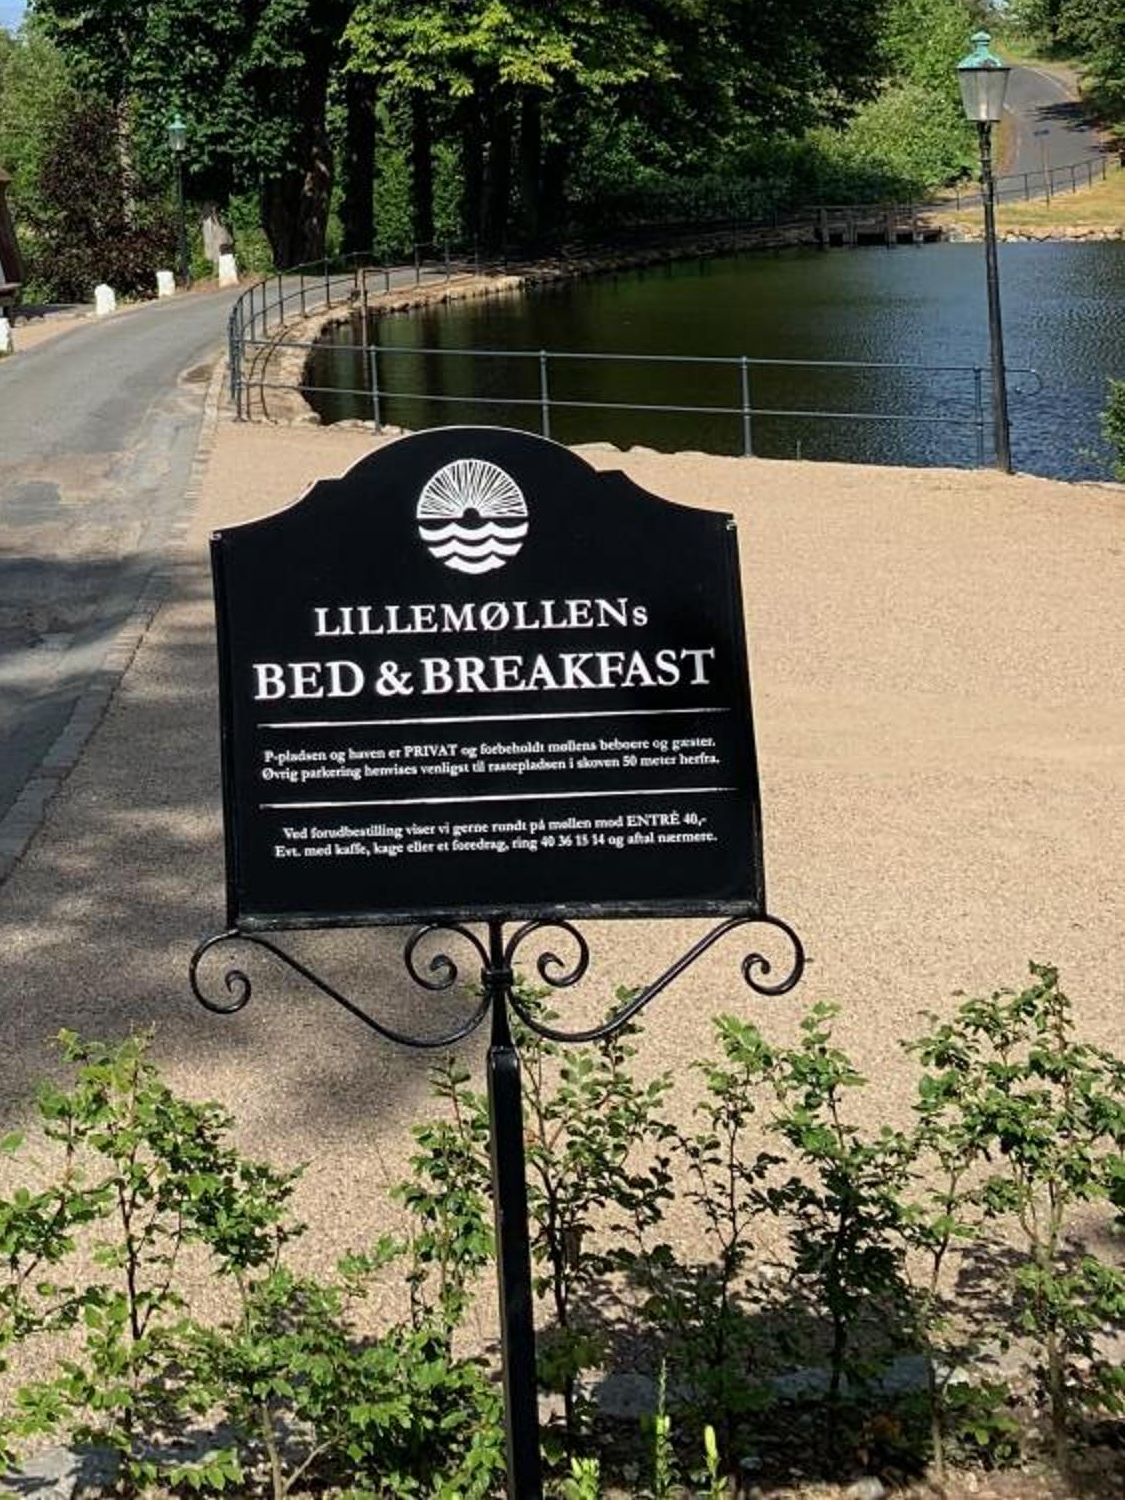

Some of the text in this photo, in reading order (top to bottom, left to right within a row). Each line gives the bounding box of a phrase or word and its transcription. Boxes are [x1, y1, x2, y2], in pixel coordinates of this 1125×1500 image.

[314, 597, 649, 637] LILLEMØLLENs
[252, 646, 716, 702] BED & BREAKFAST
[262, 766, 299, 783] Øvrig
[301, 765, 362, 783] parkering
[420, 761, 470, 777] venligst
[472, 759, 486, 773] til
[488, 757, 567, 775] rastepladsen
[569, 757, 575, 769] i
[576, 755, 620, 769] skoven
[622, 754, 638, 767] 50
[640, 755, 677, 767] meter
[678, 751, 721, 765] herfra.
[264, 749, 327, 767] P-pladsen
[329, 751, 346, 764] og
[348, 747, 386, 760] haven
[388, 748, 402, 759] er
[403, 743, 458, 758] PRIVAT
[460, 746, 478, 759] og
[599, 737, 650, 751] beboere
[652, 739, 669, 753] og
[282, 827, 308, 840] Ved
[310, 823, 404, 840] forudbestilling
[404, 822, 436, 836] viser
[437, 821, 450, 834] vi
[452, 822, 490, 837] gerne
[491, 819, 527, 833] rundt
[529, 817, 546, 835] på
[594, 814, 624, 829] mod
[626, 809, 681, 827] ENTRÉ
[275, 844, 302, 858] Evt.
[304, 843, 332, 857] med
[334, 841, 372, 858] kaffe,
[373, 840, 404, 857] kage
[406, 840, 435, 854] eller
[436, 841, 450, 853] et
[452, 837, 510, 853] foredrag,
[512, 835, 538, 852] ring
[540, 834, 556, 848] 40
[557, 834, 574, 848] 36
[608, 834, 625, 849] og
[626, 831, 656, 845] aftal
